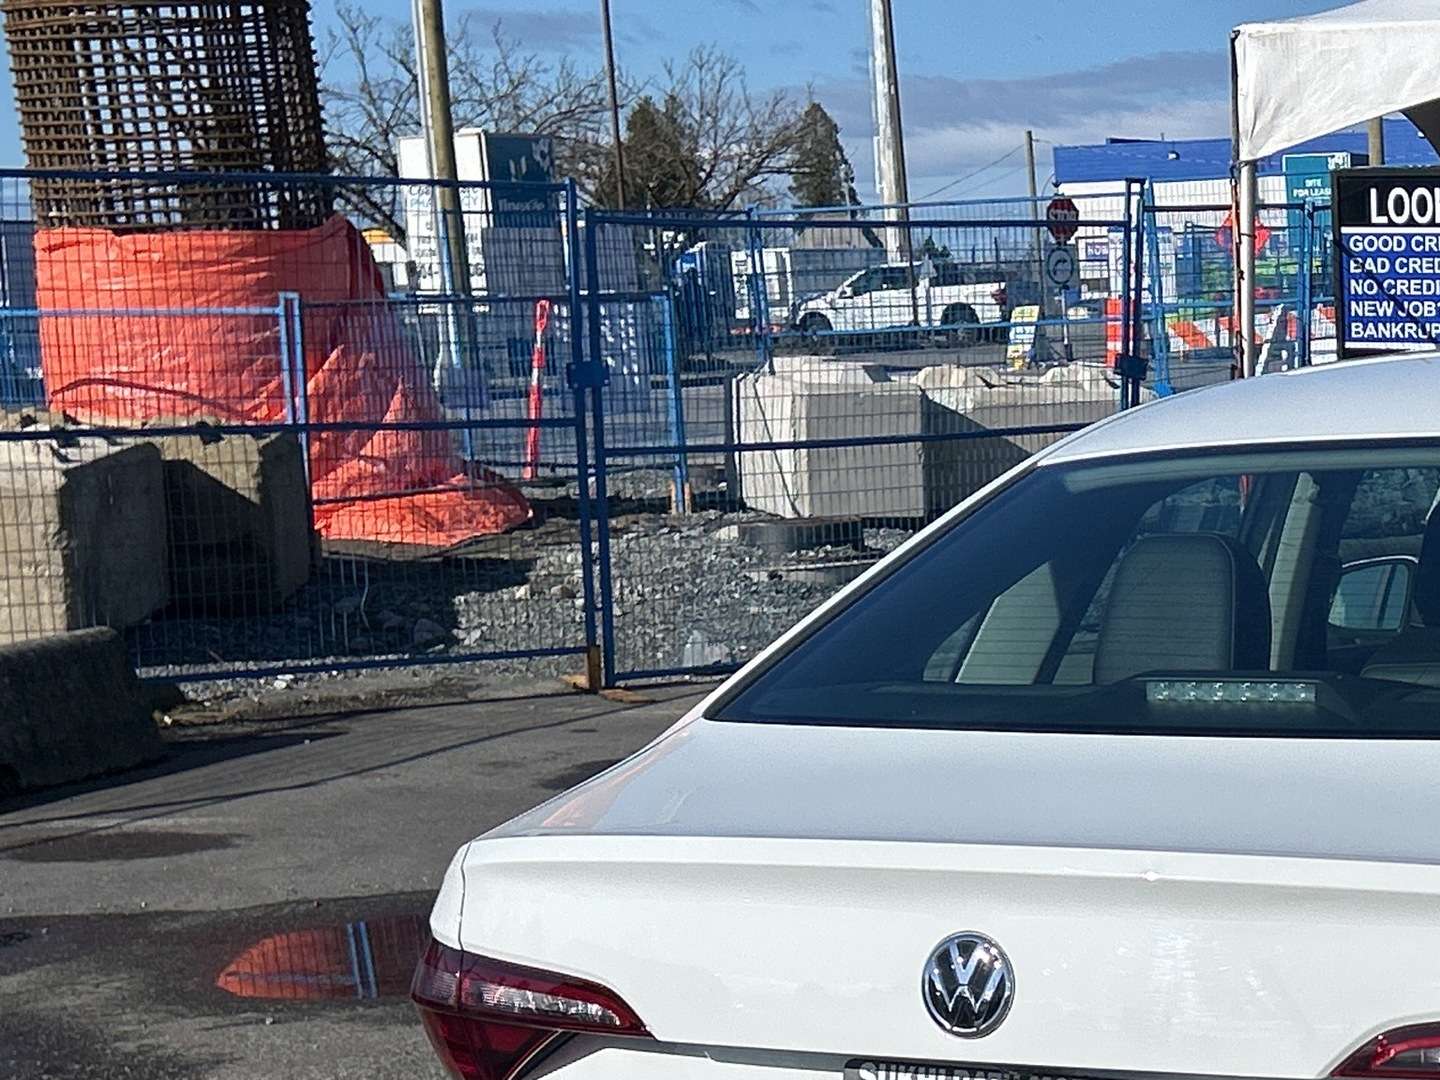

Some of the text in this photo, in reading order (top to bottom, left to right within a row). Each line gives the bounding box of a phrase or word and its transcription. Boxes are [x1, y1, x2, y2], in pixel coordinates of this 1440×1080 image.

[1350, 235, 1406, 252] GOOD
[1350, 257, 1390, 274] BAD
[1350, 279, 1378, 296] NO
[1351, 301, 1394, 317] NEW
